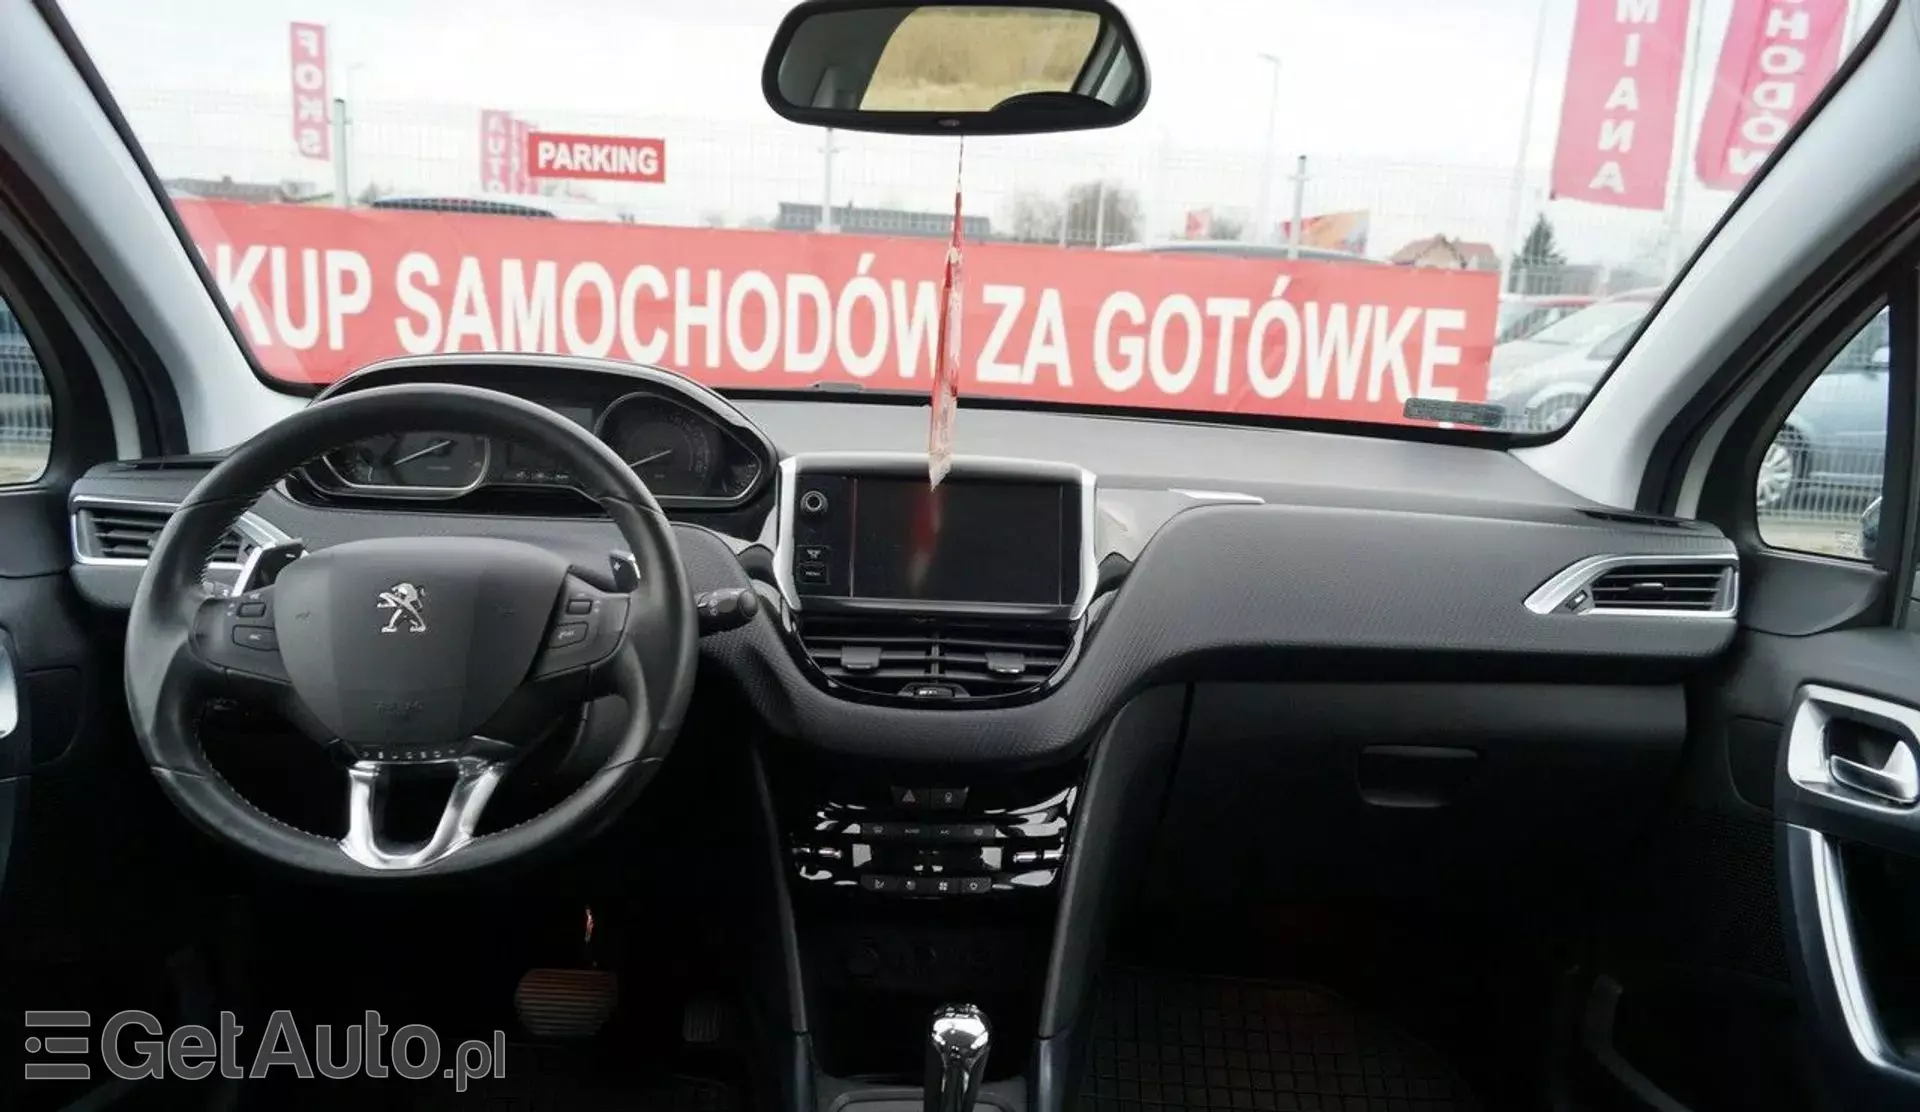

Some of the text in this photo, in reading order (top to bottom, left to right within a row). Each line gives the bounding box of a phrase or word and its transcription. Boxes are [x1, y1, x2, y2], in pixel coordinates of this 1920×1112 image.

[537, 141, 659, 175] PARKING
[198, 243, 1466, 404] KUP SAMOCHODÓW ZA GOTÓWKE
